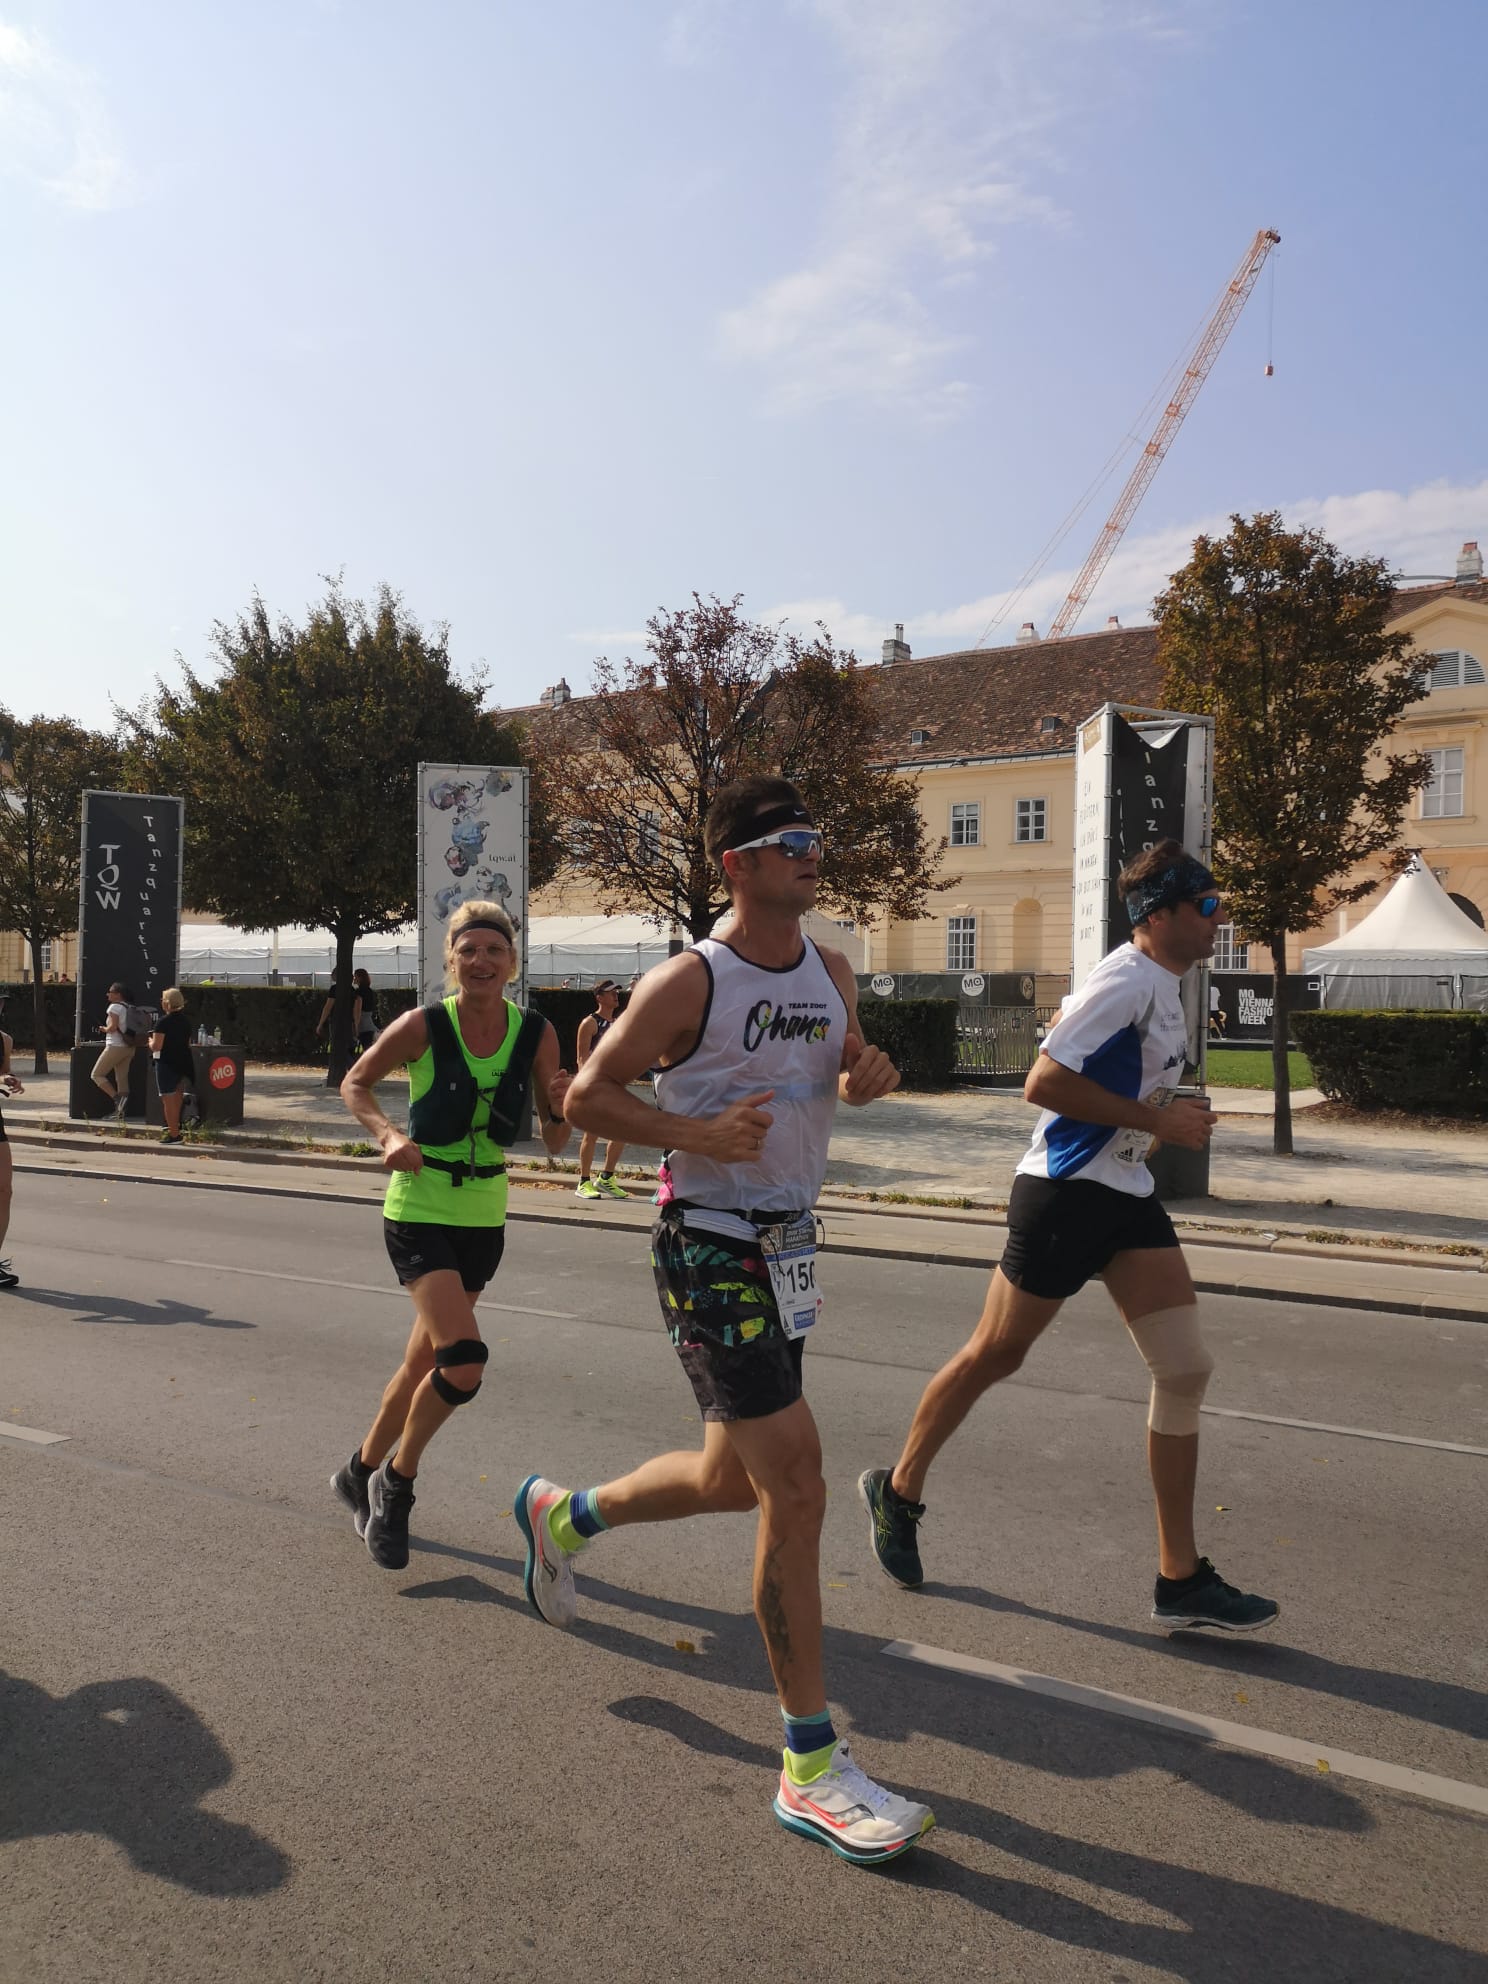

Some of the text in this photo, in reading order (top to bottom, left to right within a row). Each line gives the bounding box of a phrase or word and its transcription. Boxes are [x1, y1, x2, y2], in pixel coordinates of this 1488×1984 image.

[95, 844, 121, 910] TQW
[138, 815, 162, 989] Tanzquartier
[873, 977, 893, 989] MQ
[964, 976, 983, 989] MQ
[1239, 998, 1274, 1007] VIENNA
[1239, 1006, 1273, 1017] FASHIO
[1239, 1015, 1266, 1025] WEEK
[212, 1064, 236, 1081] MQ
